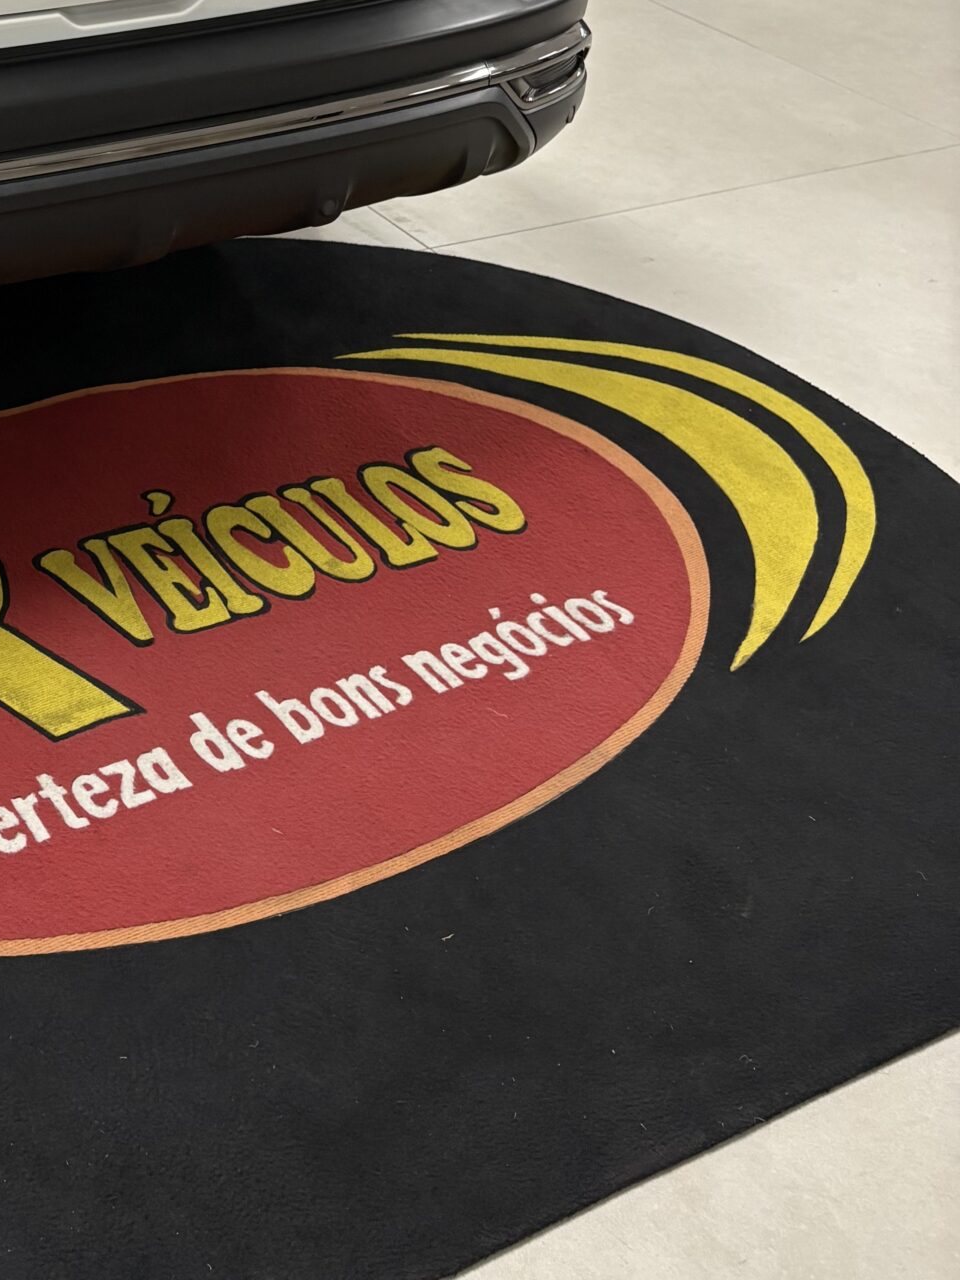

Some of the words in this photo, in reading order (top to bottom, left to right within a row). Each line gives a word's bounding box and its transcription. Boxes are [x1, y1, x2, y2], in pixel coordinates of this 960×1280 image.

[32, 444, 528, 648] VEÍCULOS
[189, 711, 275, 774] de
[254, 665, 413, 745] bons
[401, 589, 635, 695] negócios
